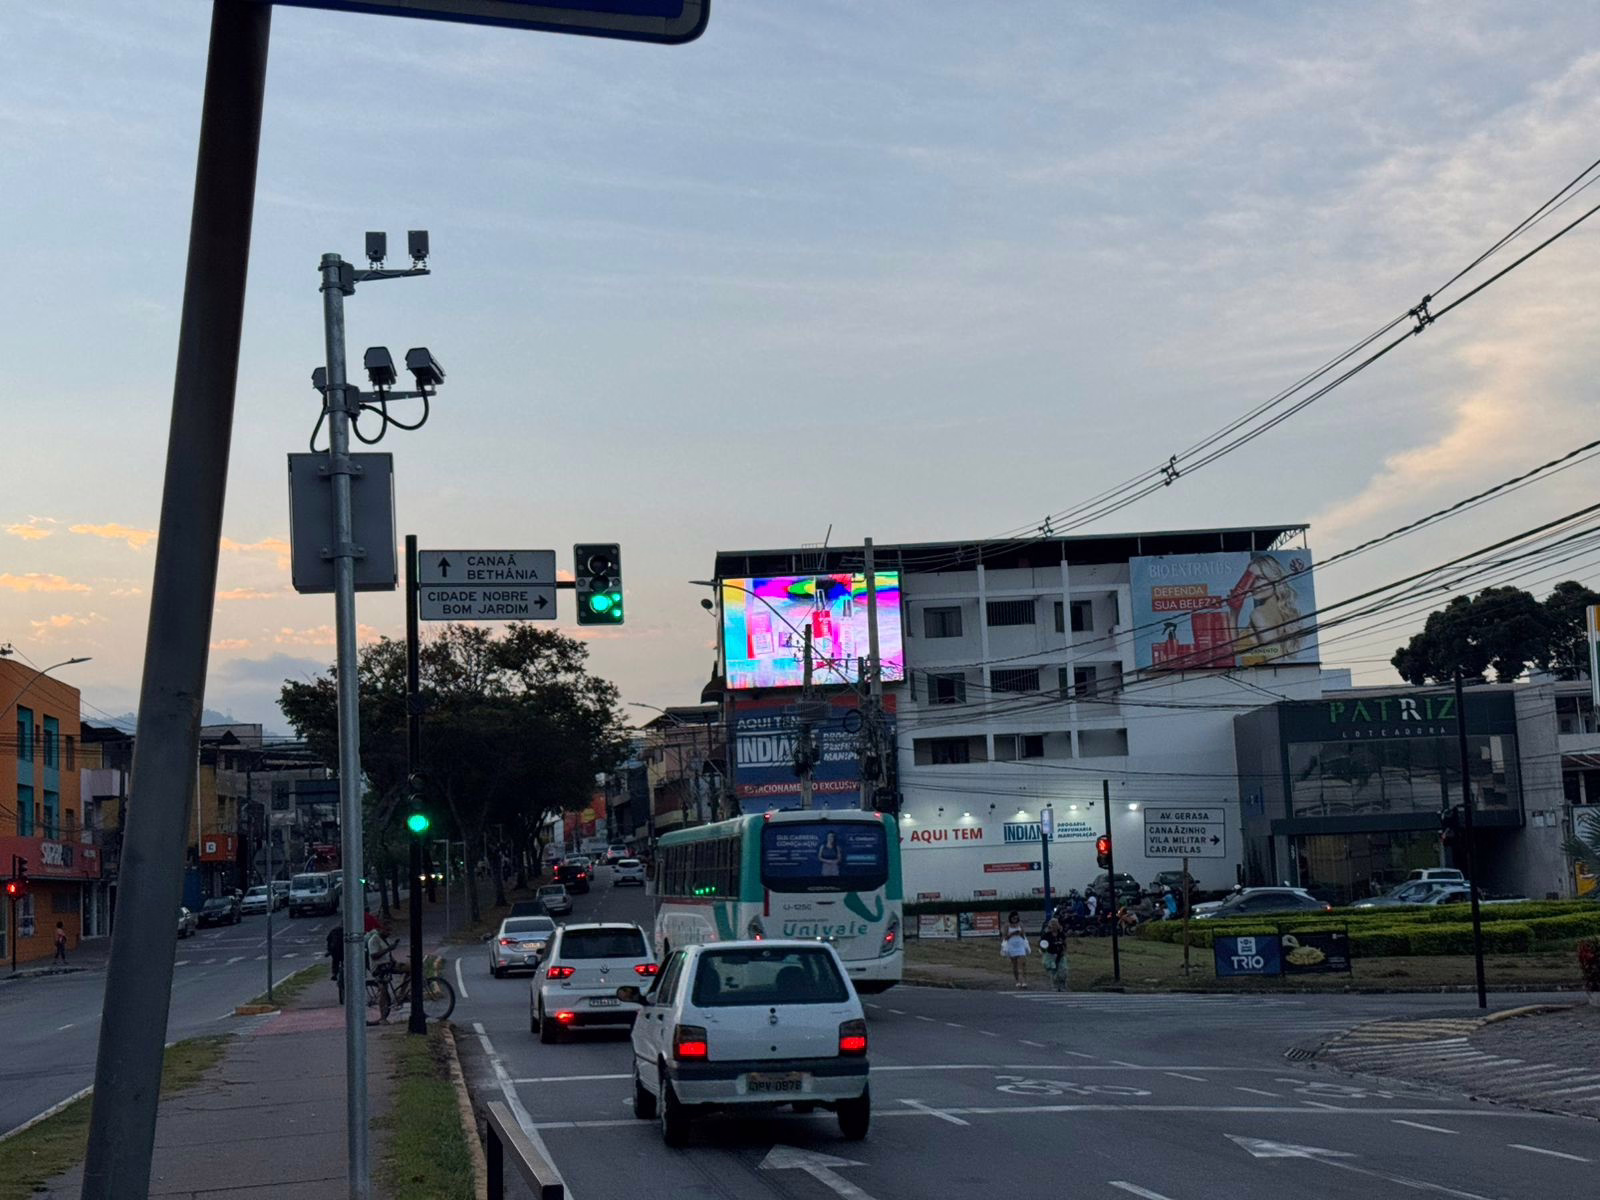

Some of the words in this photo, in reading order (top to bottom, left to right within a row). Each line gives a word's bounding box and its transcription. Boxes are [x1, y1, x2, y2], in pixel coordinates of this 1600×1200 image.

[428, 591, 477, 602] CIDADE
[483, 591, 528, 602] NOBRE
[1153, 586, 1205, 597] DEFENDA
[443, 604, 472, 614] BOM
[478, 604, 529, 614] JARDIM
[1154, 600, 1178, 610] SUA
[1328, 696, 1457, 723] PATRIZ
[737, 717, 771, 730] AQUI
[1342, 726, 1446, 738] LOTEADORA
[1174, 812, 1209, 820] GERASA
[910, 830, 948, 843] AQUI
[952, 827, 983, 840] TEM
[1149, 836, 1169, 844] VILA
[1172, 836, 1207, 844] MILITAR
[1149, 846, 1201, 854] CARAVELAS
[783, 921, 868, 936] Univale
[1231, 955, 1264, 969] TRIO
